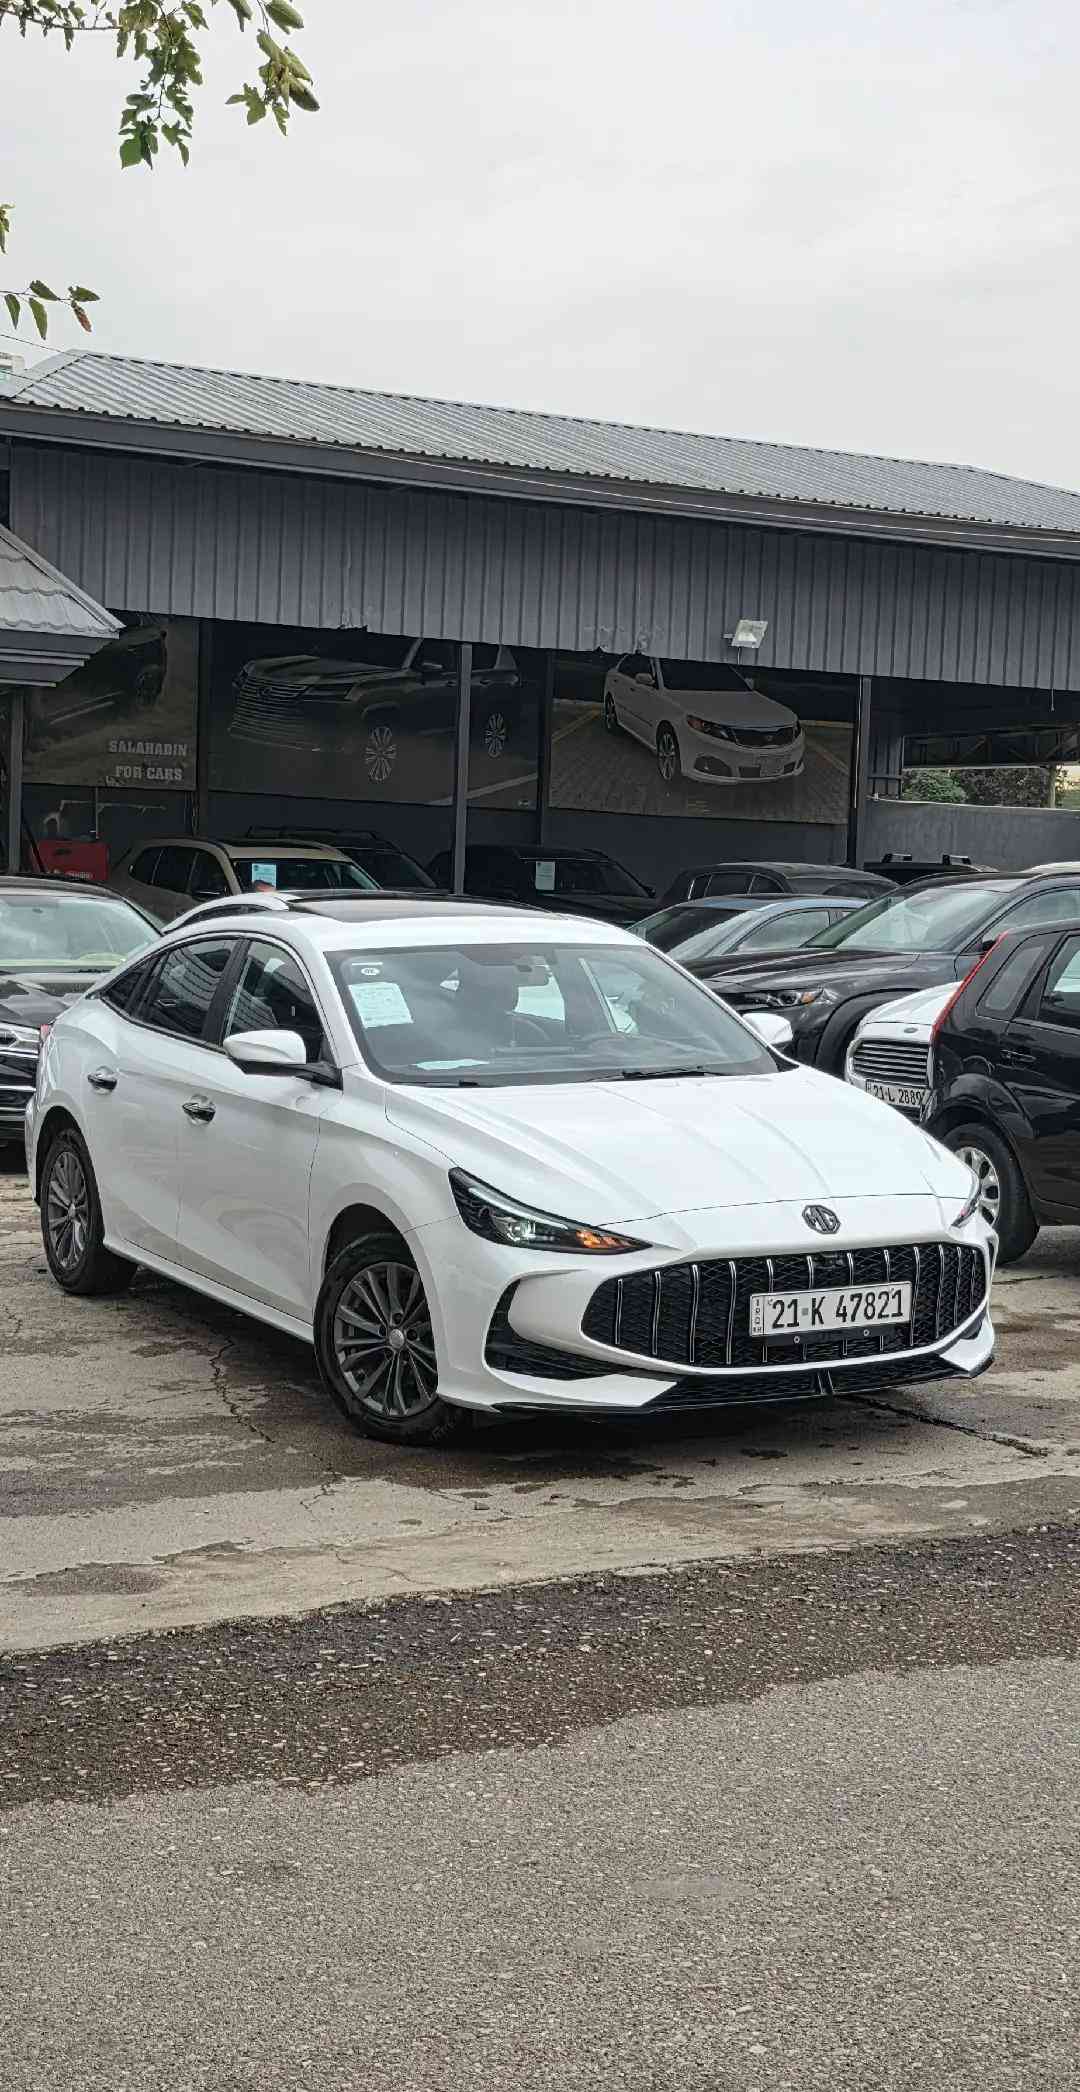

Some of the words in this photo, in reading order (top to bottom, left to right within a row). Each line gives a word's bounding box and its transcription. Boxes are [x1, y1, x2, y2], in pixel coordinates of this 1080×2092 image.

[110, 740, 187, 757] SALAHADIN
[115, 765, 143, 780] FOR
[146, 766, 183, 780] CARS
[801, 1204, 841, 1234] MG
[835, 1289, 904, 1323] 47821
